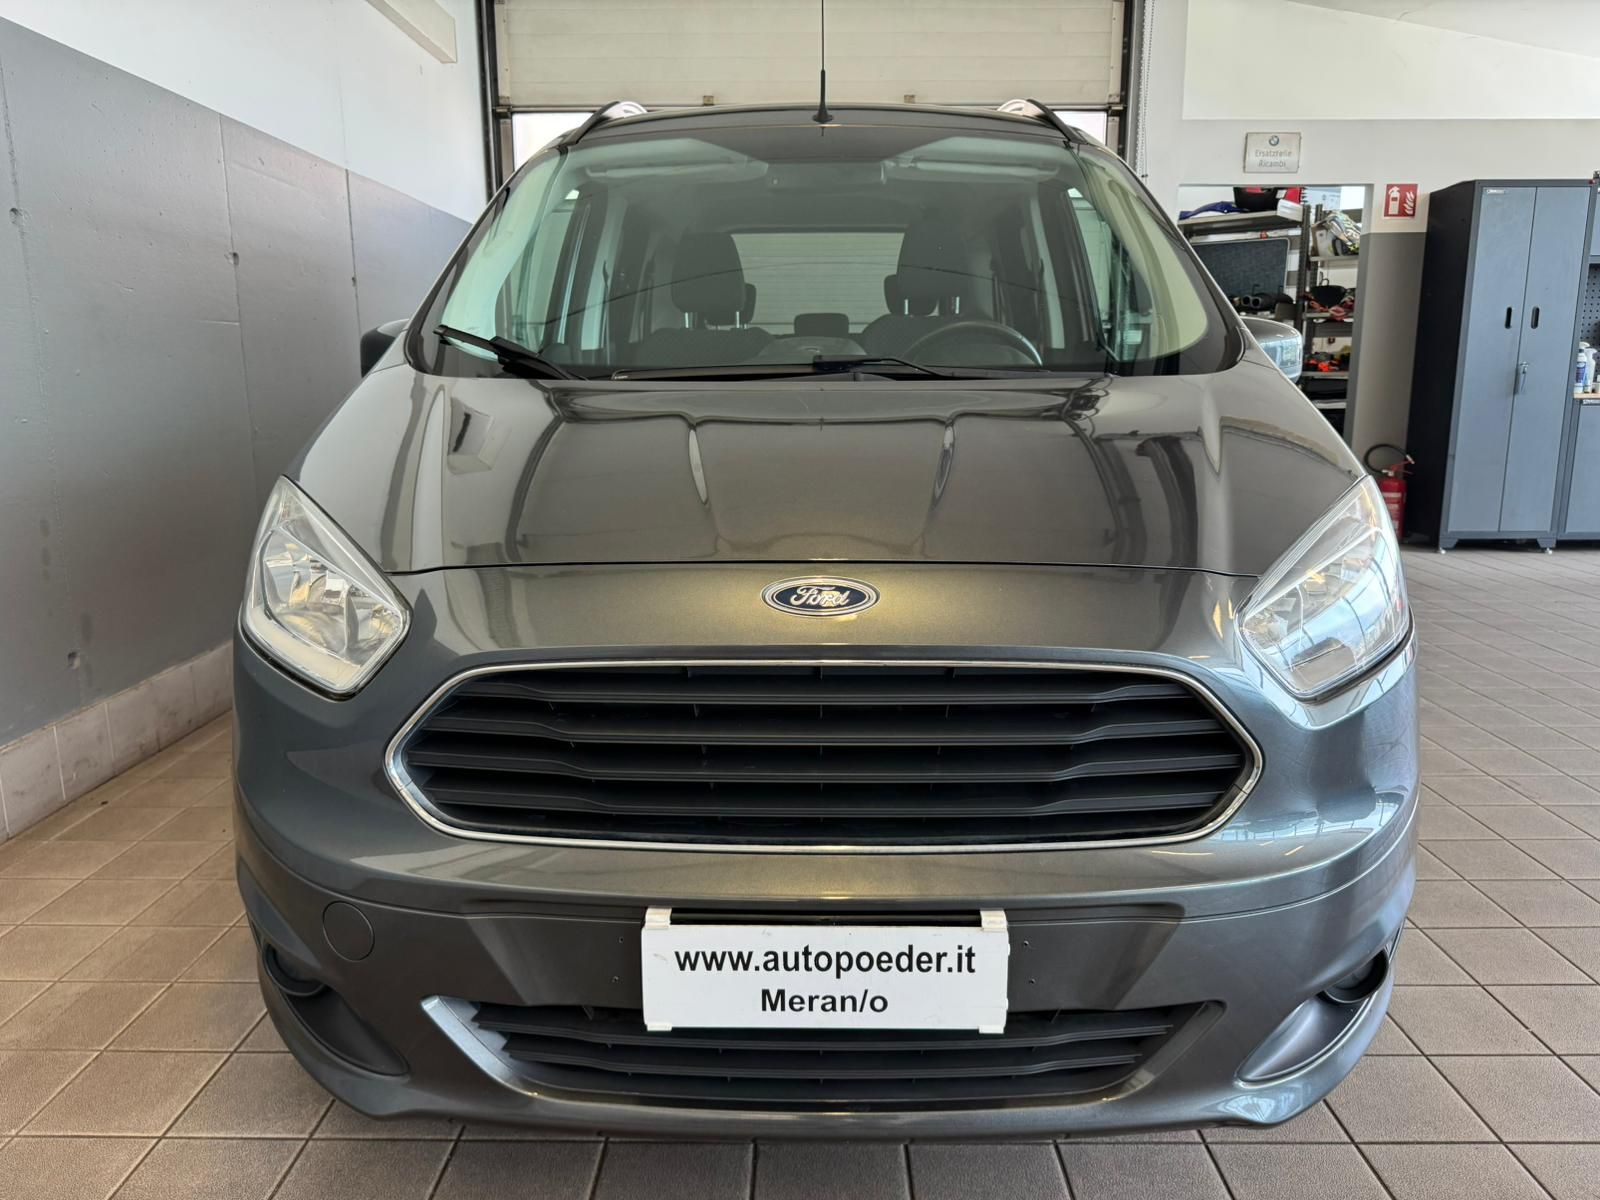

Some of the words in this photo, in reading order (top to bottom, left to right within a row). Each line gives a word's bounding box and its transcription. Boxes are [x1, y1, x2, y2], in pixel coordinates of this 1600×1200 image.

[1258, 160, 1287, 168] Ricambi
[789, 585, 850, 607] Ford
[675, 945, 976, 979] www.autopoeder.it
[761, 988, 889, 1013] Meran/o
